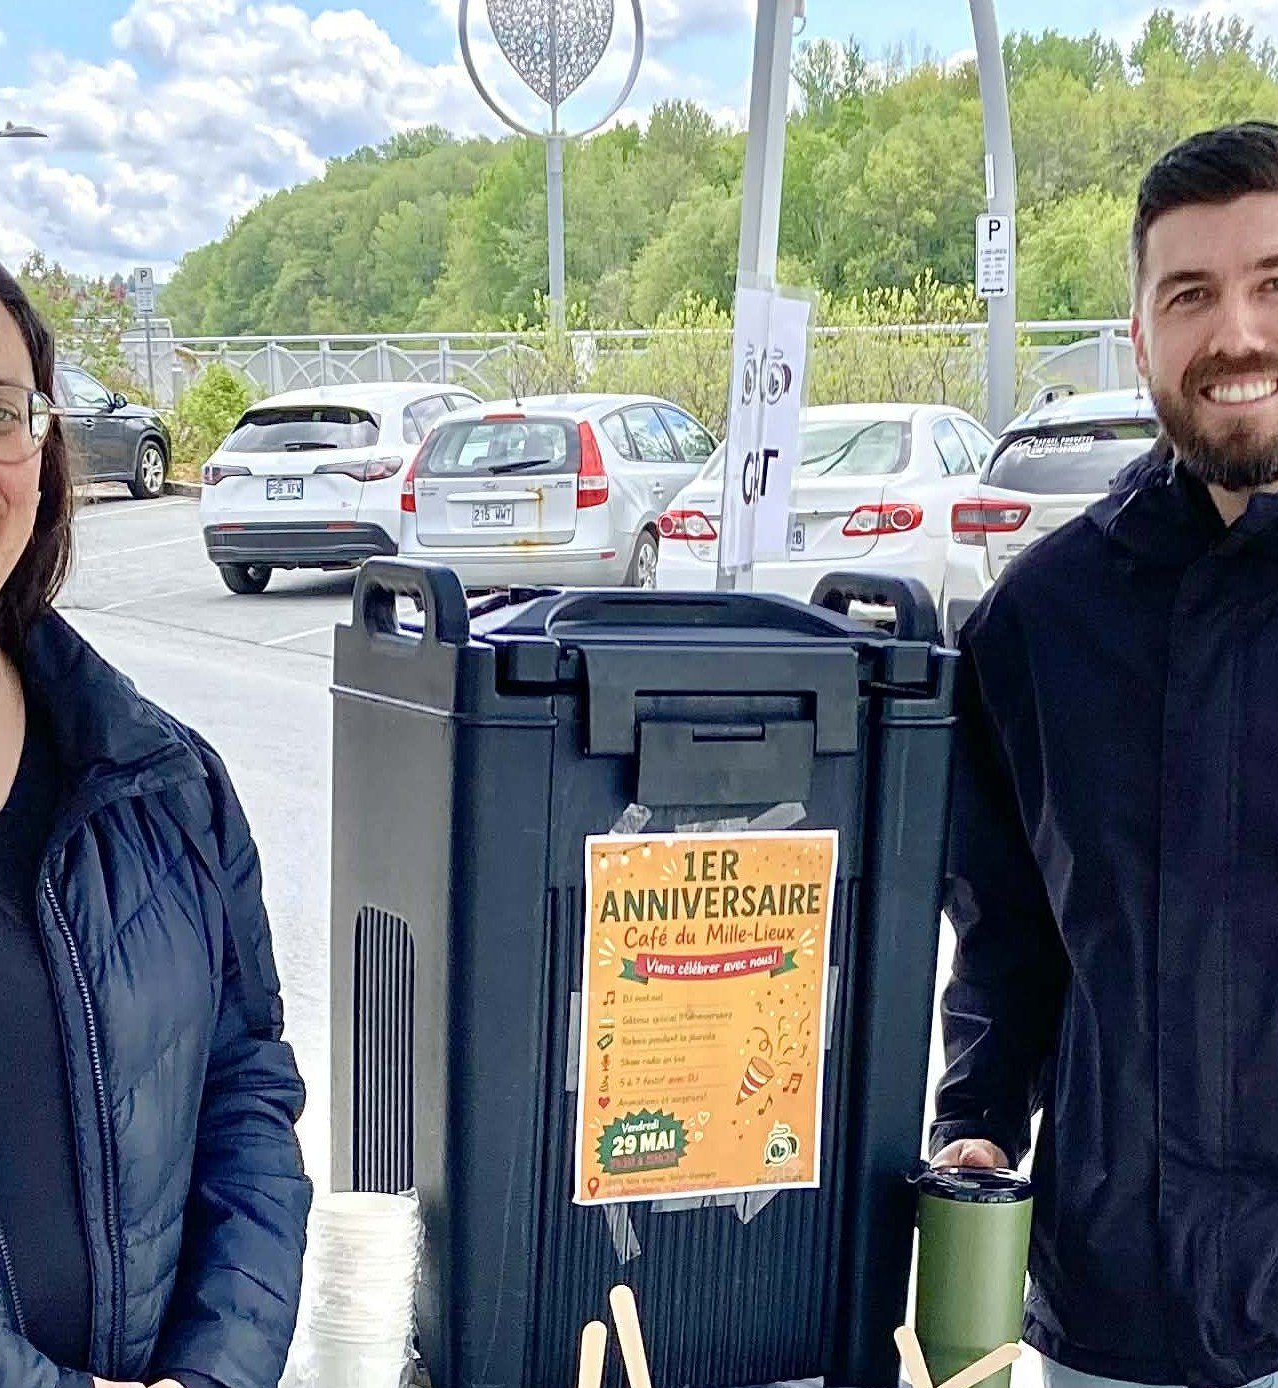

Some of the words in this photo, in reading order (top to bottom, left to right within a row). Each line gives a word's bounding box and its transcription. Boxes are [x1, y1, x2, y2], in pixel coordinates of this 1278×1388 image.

[989, 219, 1001, 241] P
[683, 849, 739, 882] 1ER
[599, 883, 822, 923] ANNIVERSAIRE
[624, 926, 668, 950] Café
[675, 926, 696, 946] du
[706, 923, 796, 946] Mille-Lieux
[645, 957, 675, 975] Viens
[677, 959, 722, 976] célébrer
[723, 957, 747, 972] avec
[749, 951, 779, 968] nous!
[621, 1119, 660, 1133] Vendredi
[611, 1134, 637, 1157] 29
[640, 1129, 676, 1153] MAI
